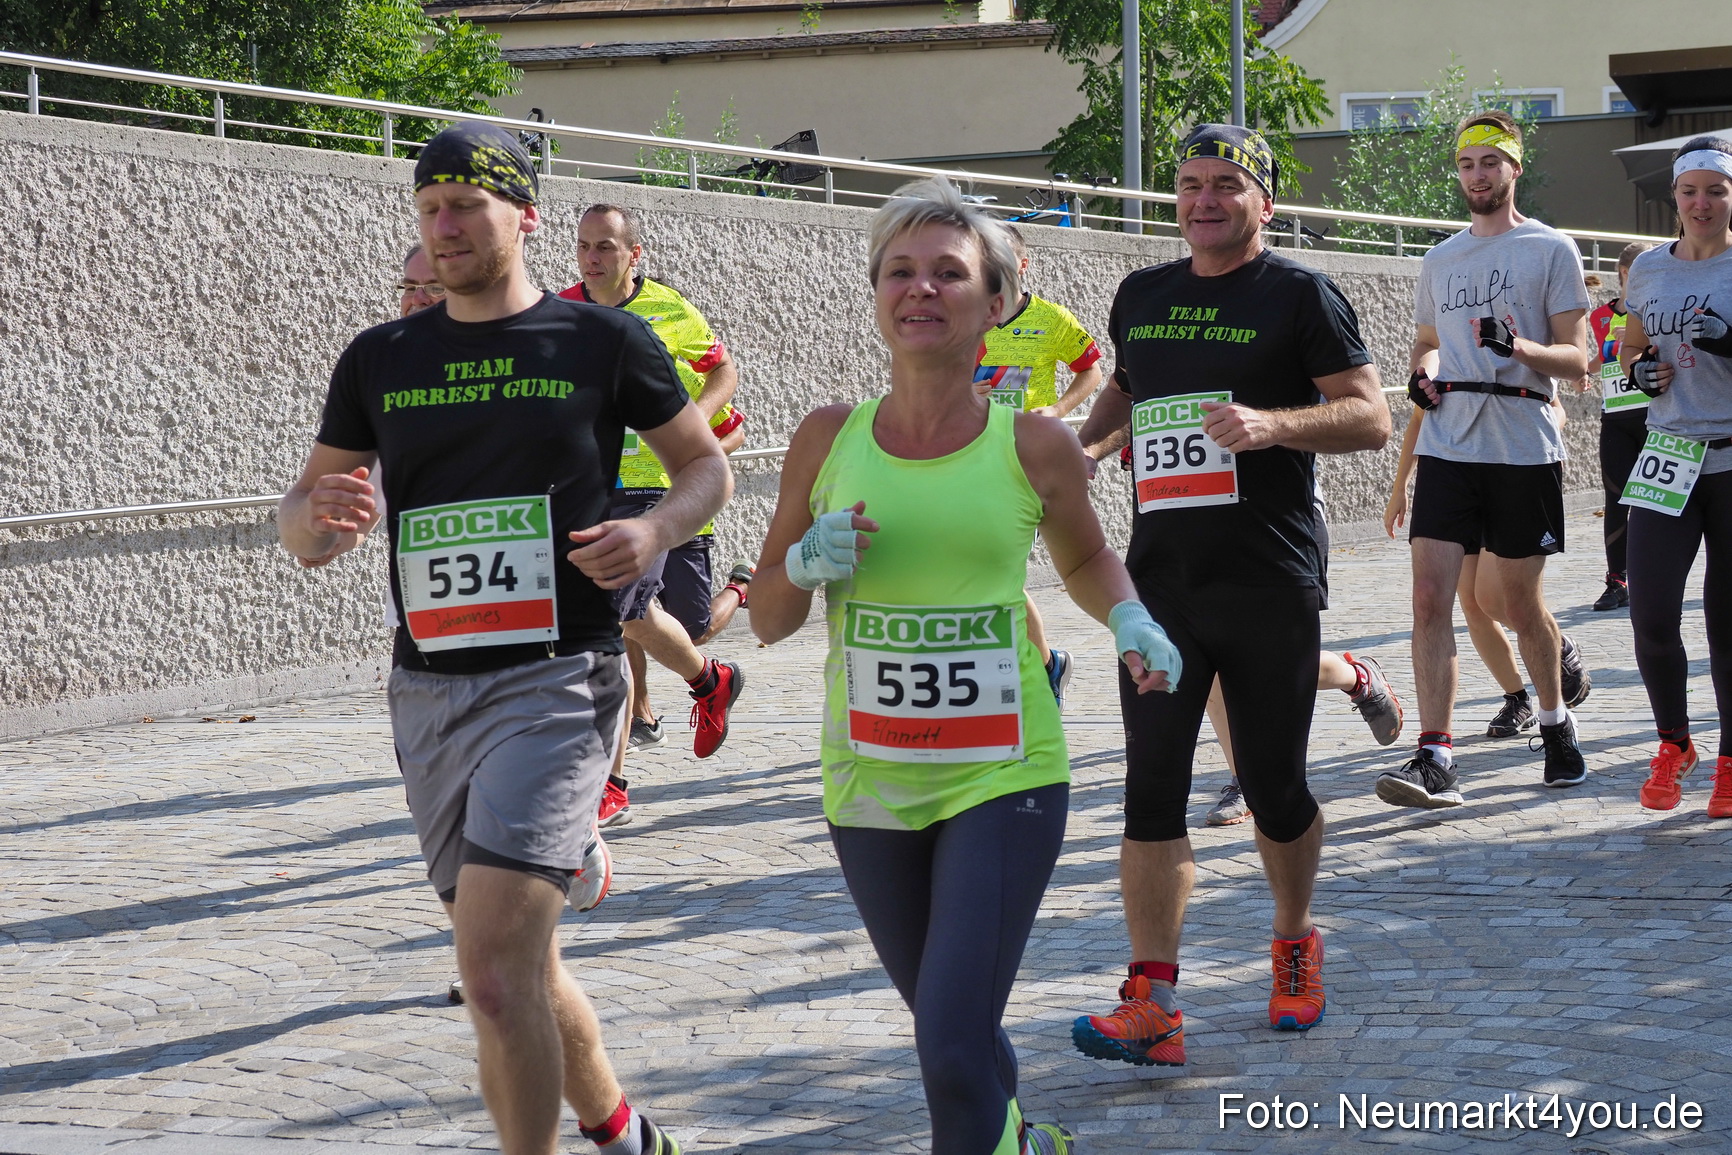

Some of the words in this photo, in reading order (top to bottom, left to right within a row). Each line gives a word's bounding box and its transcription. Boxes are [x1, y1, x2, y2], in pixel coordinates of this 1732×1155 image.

[1168, 306, 1219, 322] TEAM
[1126, 324, 1201, 342] FORREST
[1203, 326, 1257, 343] GUMP
[444, 357, 514, 382] TEAM
[1603, 364, 1622, 377] BO
[383, 383, 496, 413] FORREST
[502, 378, 575, 399] GUMP
[1145, 433, 1207, 472] 536
[1646, 431, 1695, 458] OCK
[1145, 481, 1189, 500] Andreas
[1628, 484, 1666, 503] SARAH
[409, 504, 537, 547] BOCK
[428, 551, 518, 599] 534
[430, 609, 500, 633] Johannes
[854, 608, 1000, 648] BOCK
[877, 661, 980, 709] 535
[872, 718, 942, 744] Annett
